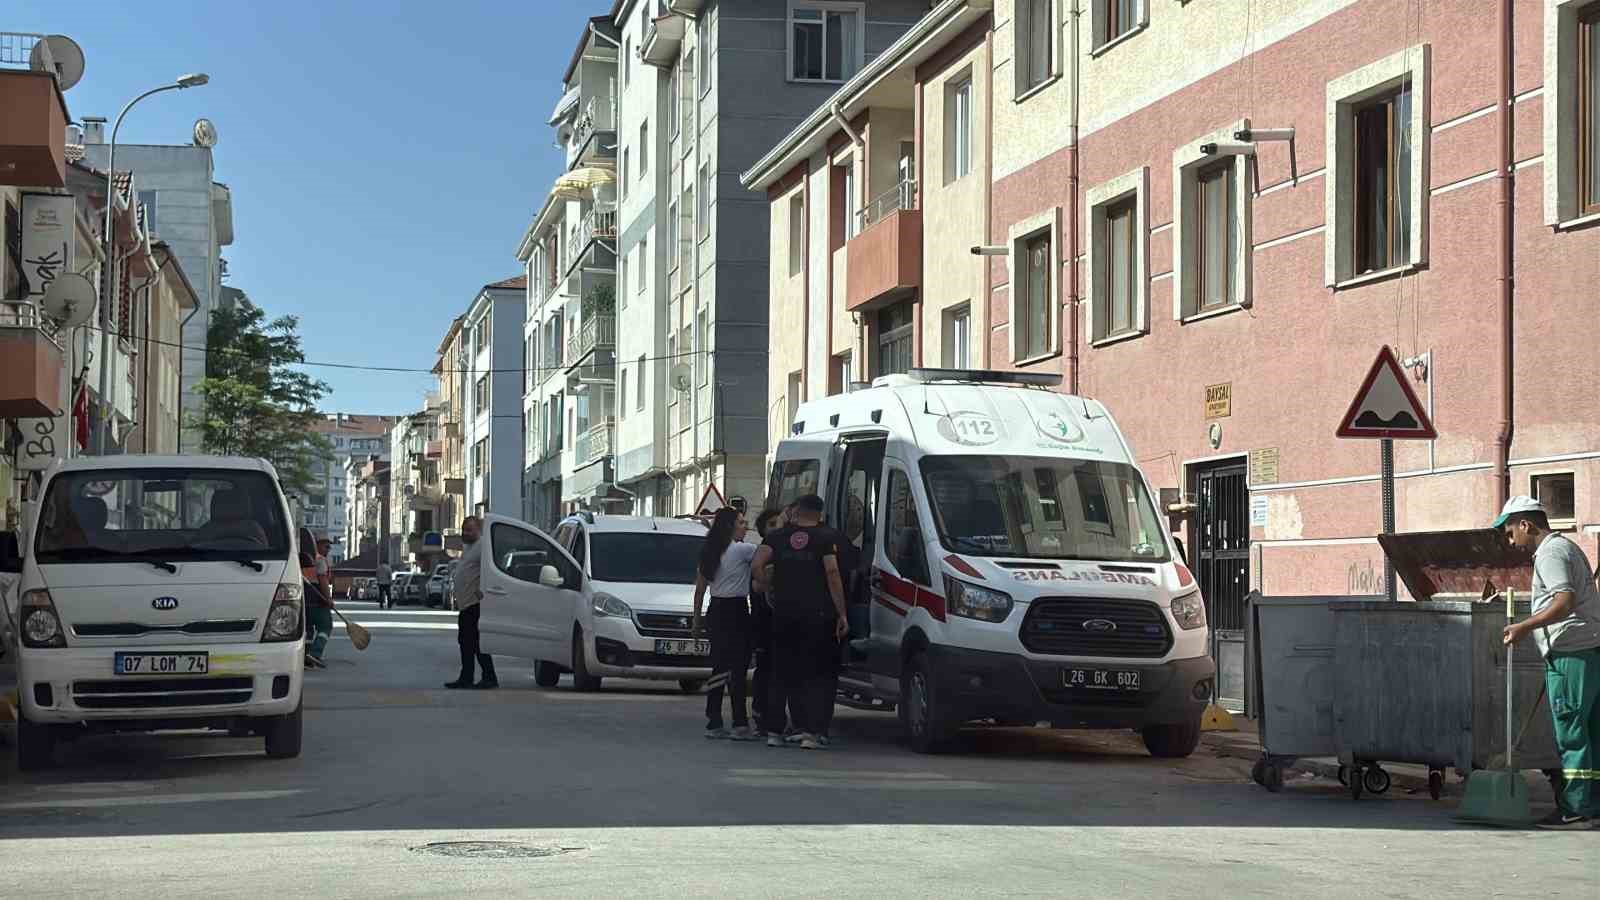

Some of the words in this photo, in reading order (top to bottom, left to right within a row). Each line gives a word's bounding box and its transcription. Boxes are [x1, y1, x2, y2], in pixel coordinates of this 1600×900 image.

[1206, 385, 1229, 403] BAYSAL
[958, 420, 994, 436] 112
[155, 599, 176, 608] KIA
[124, 656, 142, 672] 07
[151, 656, 177, 672] LOM
[187, 655, 205, 672] 74
[1071, 670, 1085, 683] 26
[1094, 671, 1108, 685] GK
[1117, 672, 1138, 686] 602
